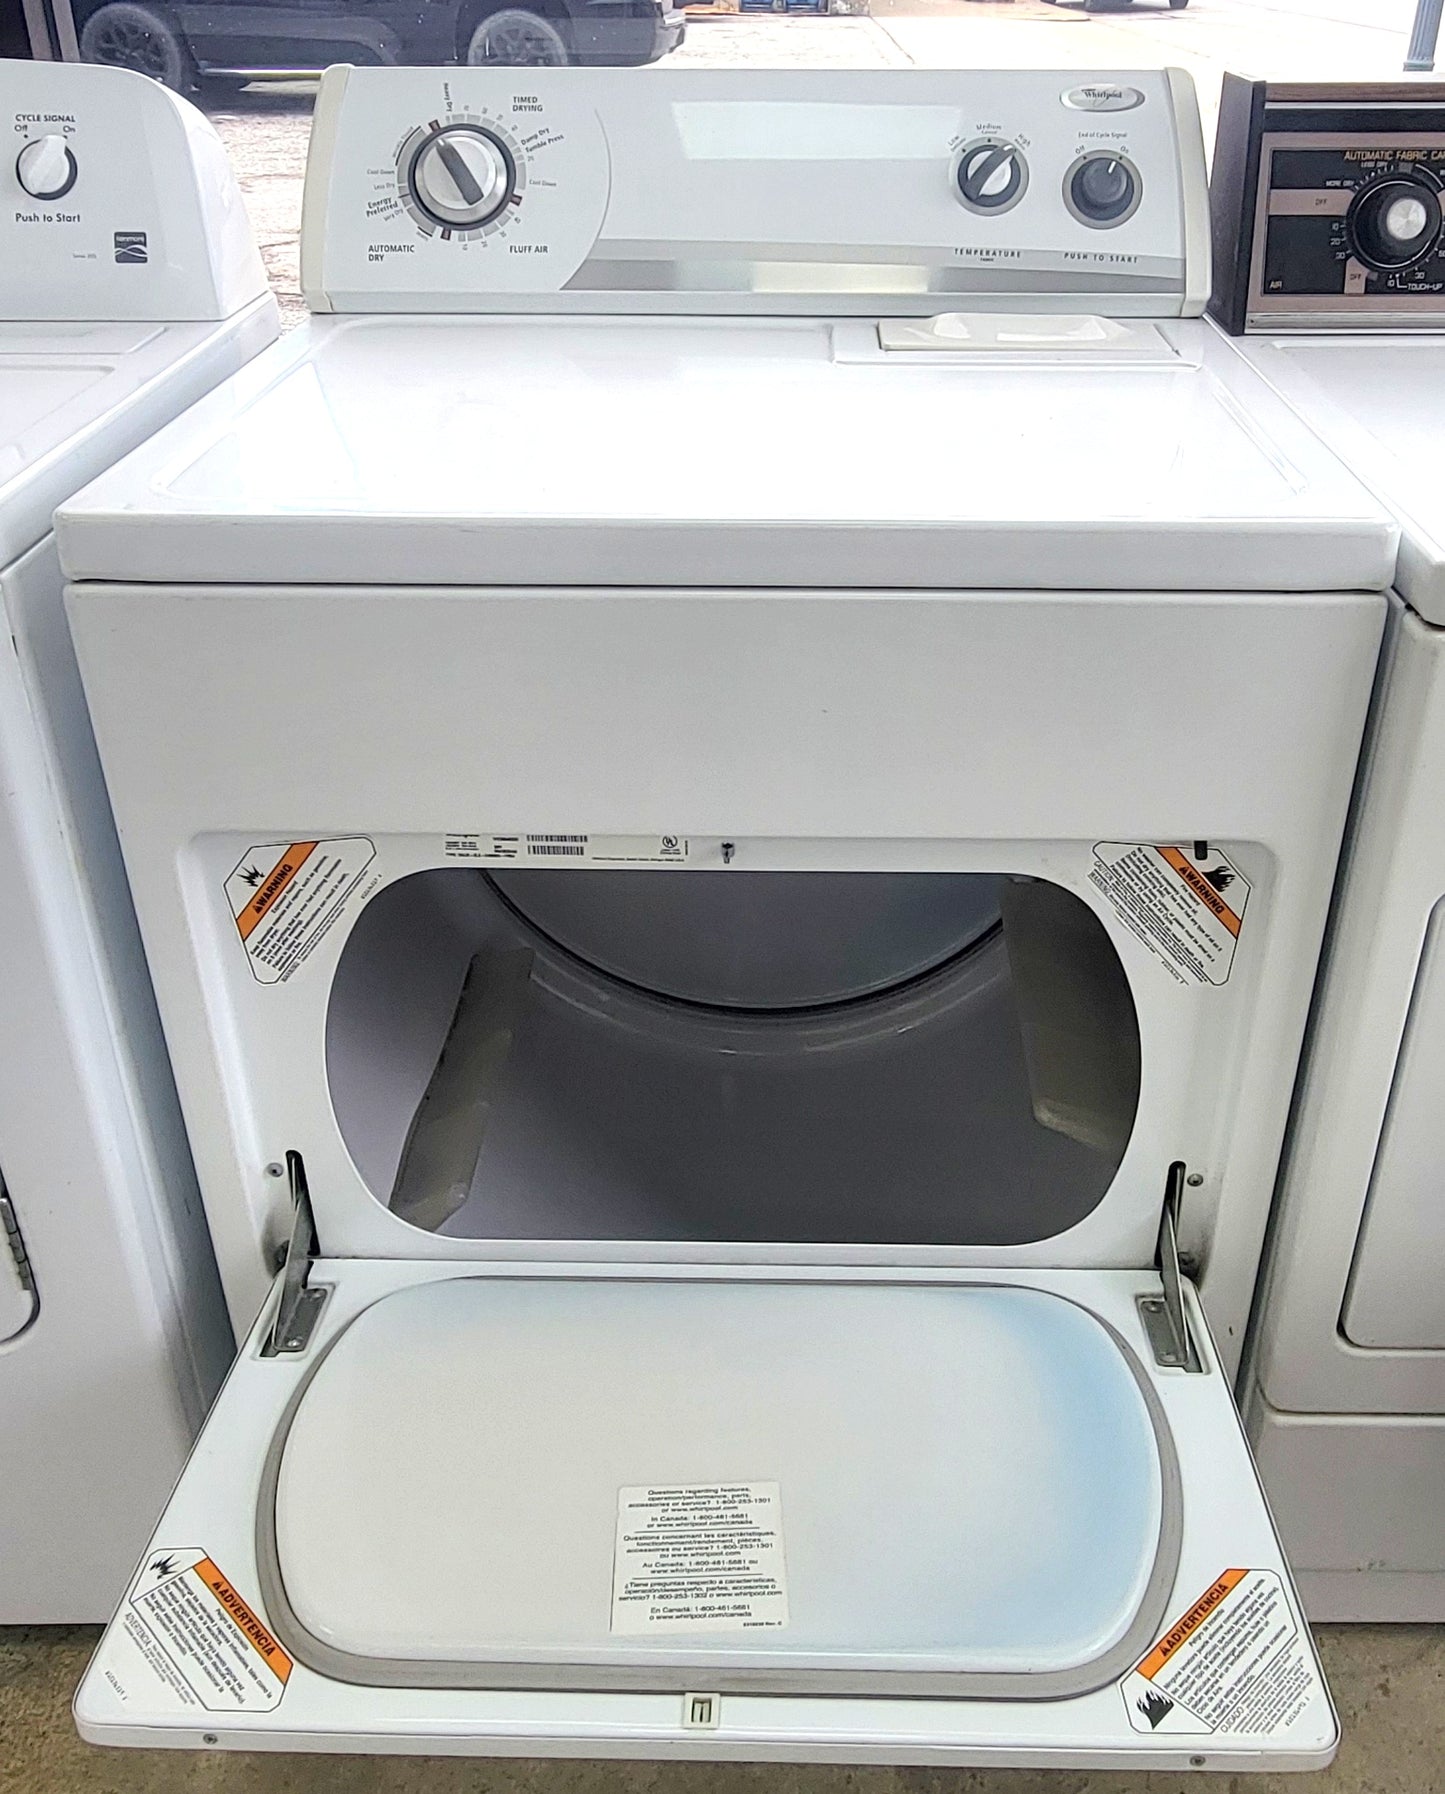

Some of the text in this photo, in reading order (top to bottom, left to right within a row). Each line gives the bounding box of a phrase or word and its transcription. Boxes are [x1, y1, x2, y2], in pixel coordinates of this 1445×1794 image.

[1081, 88, 1122, 100] Whirlpool
[513, 96, 538, 104] TIMED
[512, 104, 543, 112] DRYING
[15, 114, 76, 123] CYCLE SIGNAL
[14, 124, 28, 132] Off
[63, 125, 76, 133] On
[521, 128, 550, 145] Damp Dry
[525, 134, 565, 153] Tumble Press
[1344, 151, 1394, 160] AUTOMATIC
[1396, 151, 1428, 160] FABRIC
[367, 196, 393, 209] Energy
[366, 201, 398, 217] Preferred
[15, 213, 81, 223] Push to Start
[1332, 222, 1339, 230] 10
[1330, 238, 1341, 246] 20
[368, 245, 415, 253] AUTOMATIC
[510, 245, 548, 254] FLUFF AIR
[954, 248, 1021, 259] TEMPERATURE
[368, 254, 385, 262] DRY
[1064, 252, 1088, 260] PUSH
[1110, 255, 1138, 263] START
[1408, 283, 1443, 291] TOUCH-UP
[257, 863, 294, 908] WARNING
[1184, 871, 1225, 914] WARNING
[1165, 1583, 1229, 1650] ADVERTENCIA
[218, 1588, 276, 1657] ADVERTENCIA
